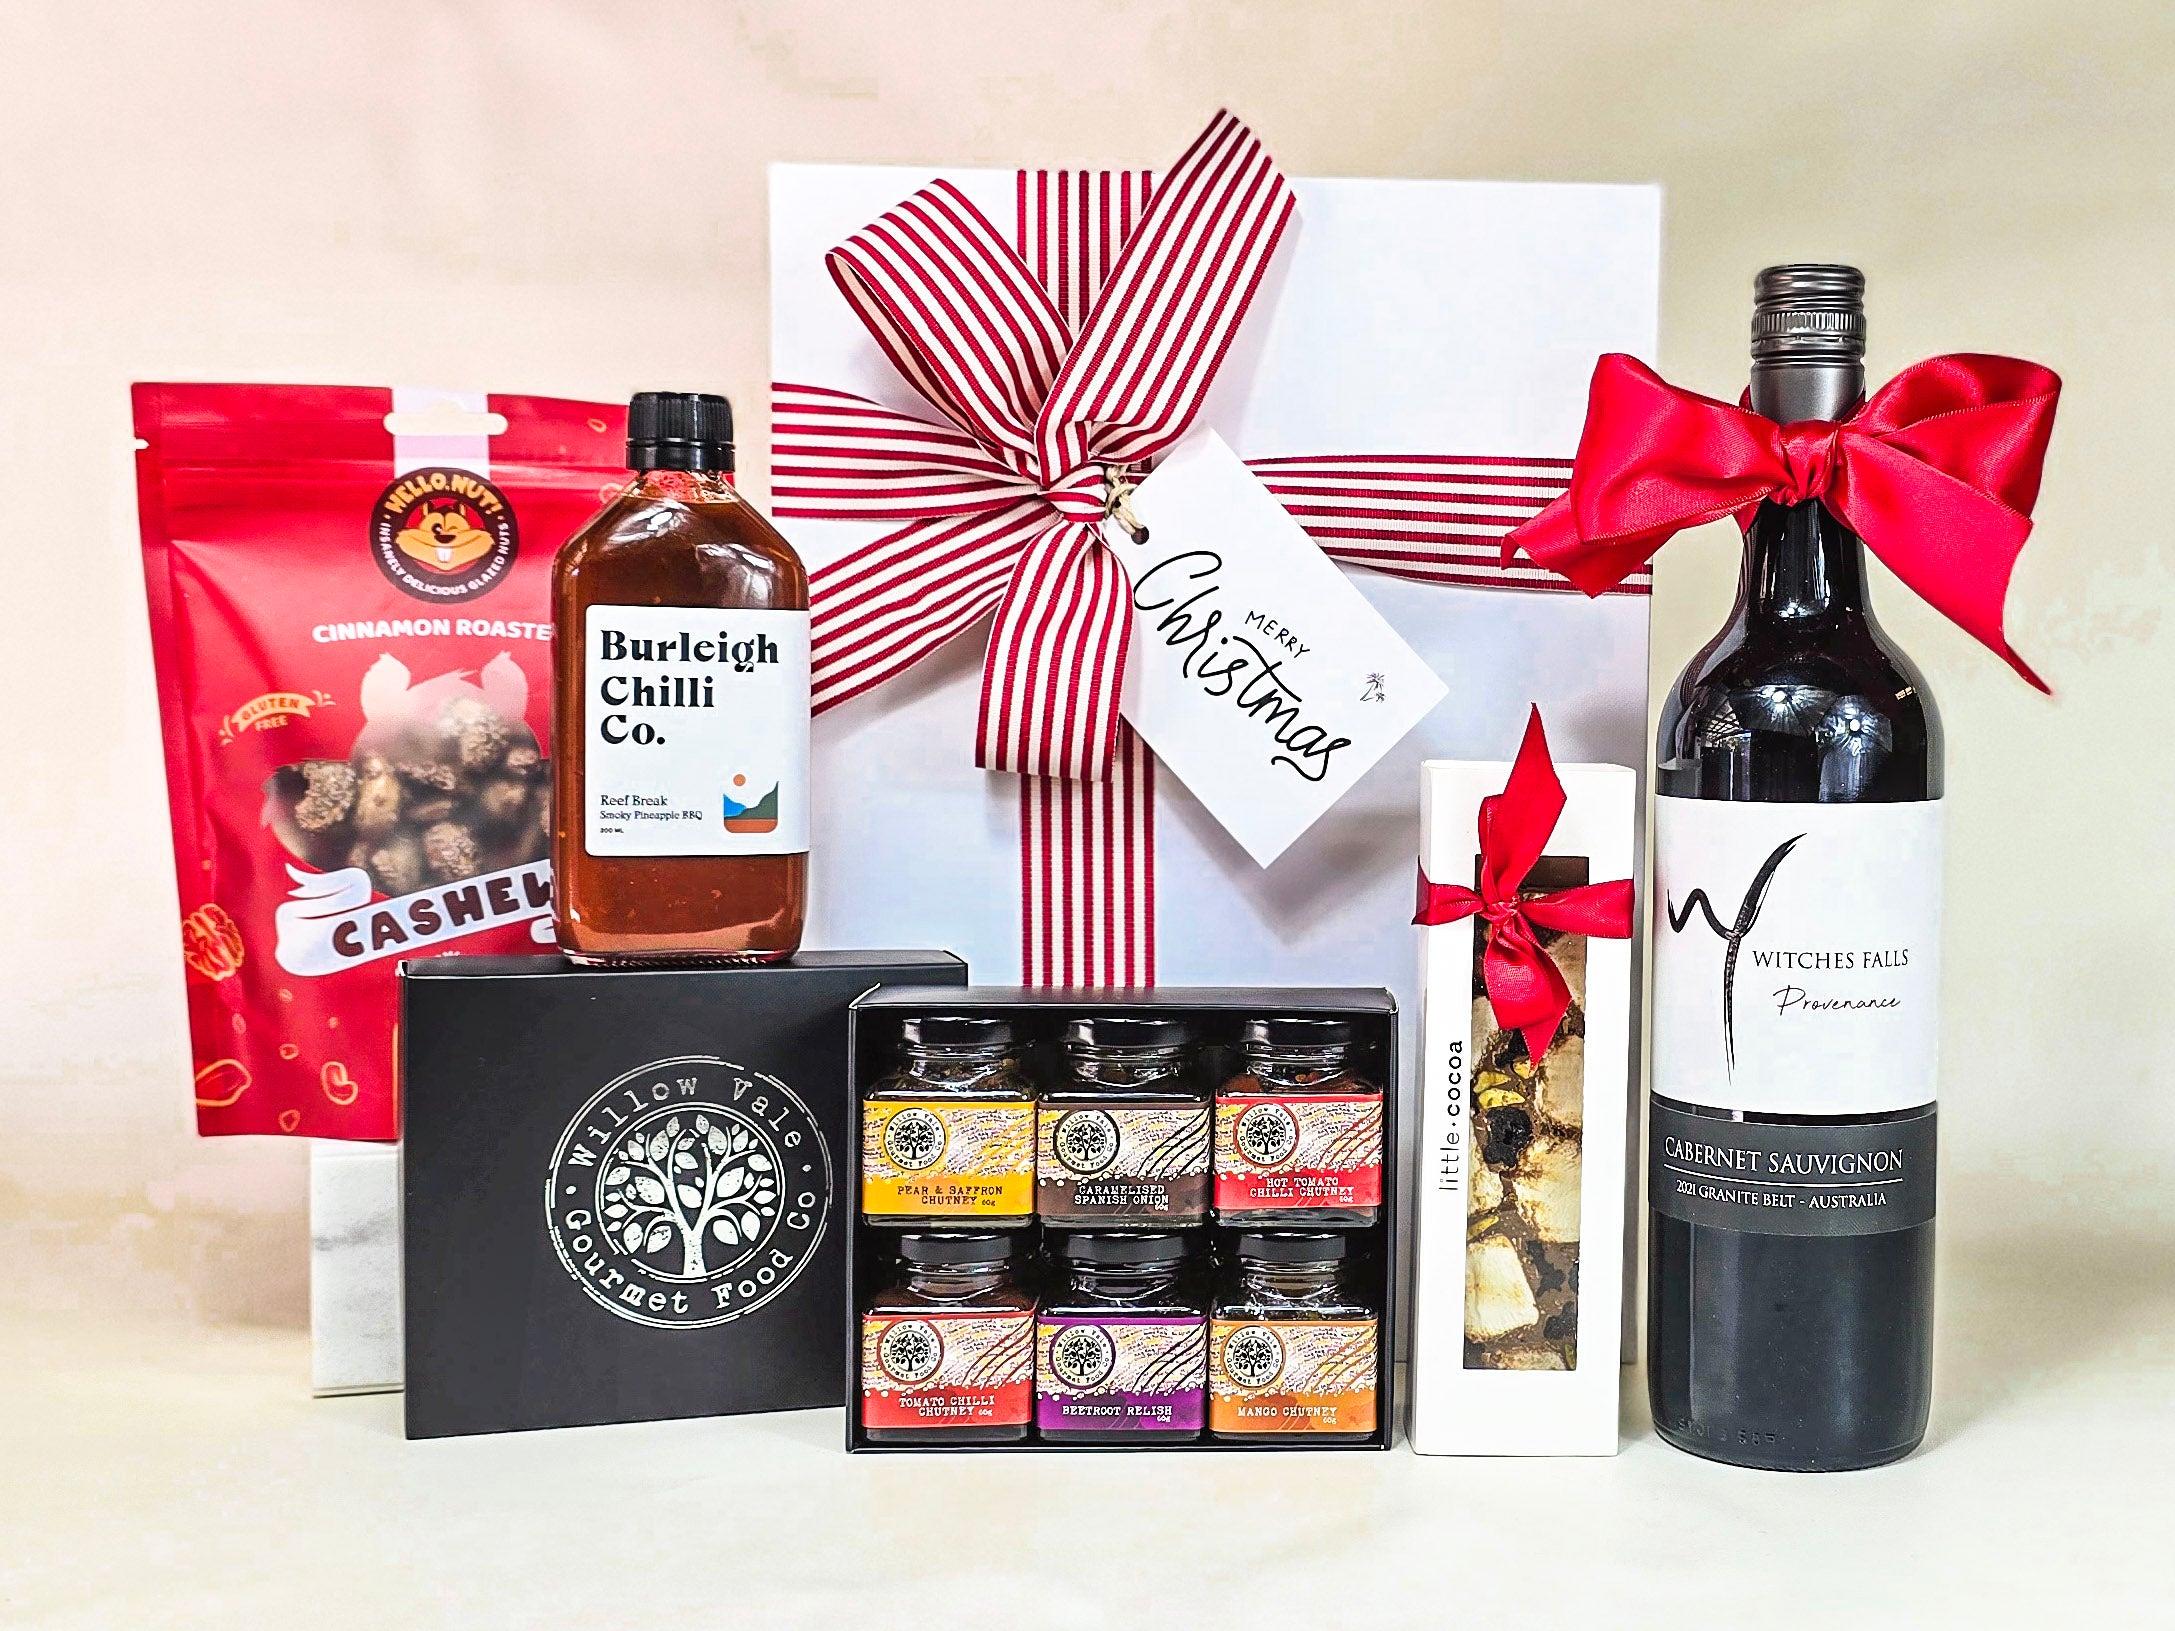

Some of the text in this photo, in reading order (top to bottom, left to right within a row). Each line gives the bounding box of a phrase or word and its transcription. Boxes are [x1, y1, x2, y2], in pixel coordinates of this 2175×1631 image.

[378, 522, 511, 596] INSANELY DELICIOUS GLAZED NUTS
[312, 619, 551, 643] CINNAMON ROASTE
[1245, 610, 1311, 659] MERRY
[600, 630, 779, 672] Burleigh
[1133, 550, 1352, 782] Christmas
[601, 675, 714, 707] Chilli
[242, 698, 300, 720] GLUTEN
[255, 715, 288, 731] FREE
[600, 714, 666, 744] Co.
[600, 794, 668, 806] Reef Break
[600, 810, 703, 821] Smoky Pineapple BBQ
[1752, 949, 1909, 969] WITCHES FALLS
[1772, 984, 1901, 1016] Provenance
[568, 1077, 698, 1167] Willow
[733, 1077, 801, 1148] Vale
[1665, 1136, 1903, 1175] CABERNET SAUVIGNON
[897, 1186, 1003, 1195] PEAR & SAFFRON
[1079, 1185, 1165, 1195] CARAMELISED
[1250, 1186, 1354, 1198] CHILLI CHUTNEY
[1266, 1177, 1339, 1188] HOT TOMATO
[921, 1196, 977, 1205] CHUTNEY
[1074, 1195, 1169, 1205] SPANISH ONION
[1676, 1180, 1696, 1196] 2021
[1698, 1185, 1759, 1206] GRANITE
[1762, 1193, 1796, 1208] BELT
[1808, 1193, 1887, 1209] AUSTRALIA
[565, 1191, 816, 1314] Gourmet Food Co
[899, 1395, 994, 1408] TOMATO CHILLI
[918, 1406, 975, 1417] CHUTNEY
[1062, 1406, 1172, 1416] BEETROOT RELISH
[1237, 1406, 1338, 1417] MANGO CHUTNEY
